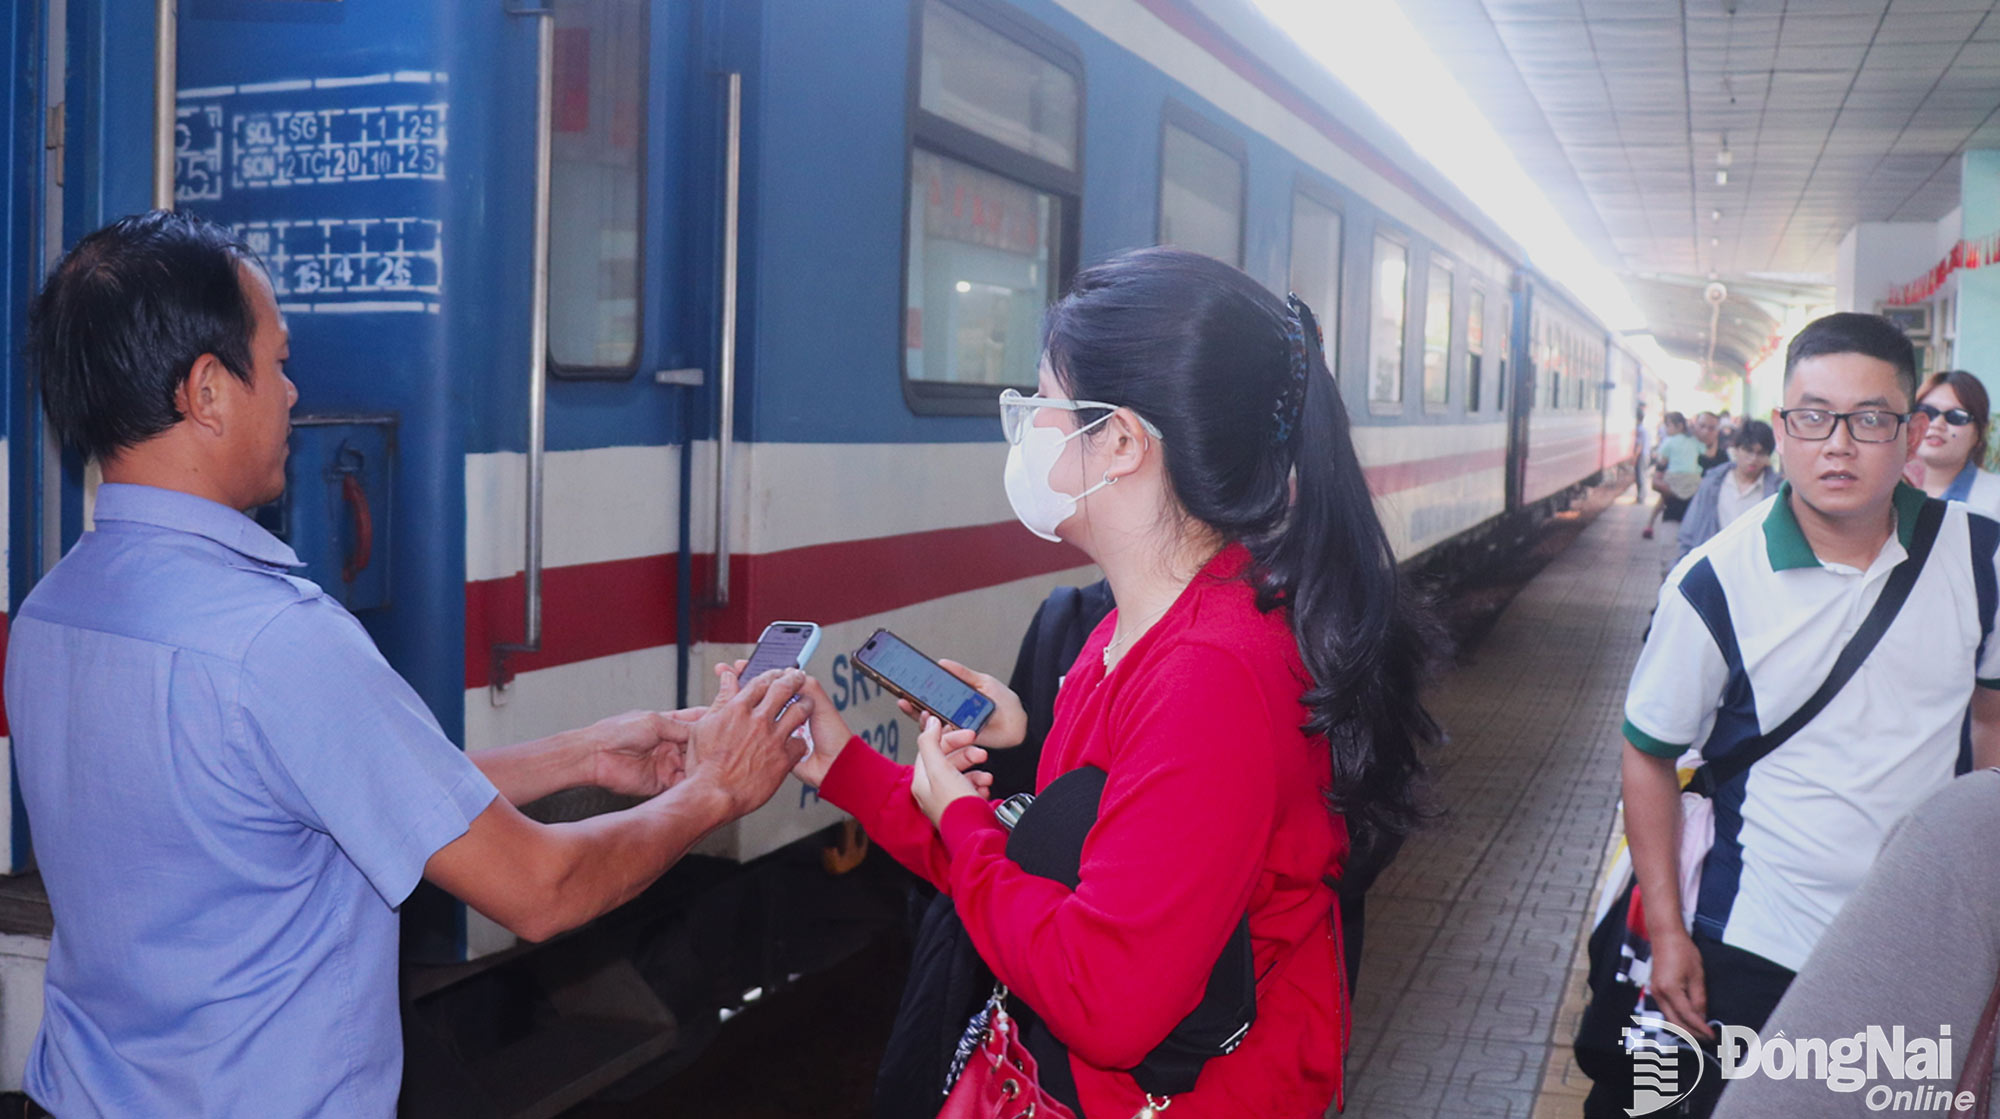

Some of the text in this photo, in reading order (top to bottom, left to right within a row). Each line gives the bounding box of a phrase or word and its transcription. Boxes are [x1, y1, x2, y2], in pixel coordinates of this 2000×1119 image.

[246, 121, 275, 145] SCL
[289, 117, 318, 141] SG
[377, 116, 386, 138] 1
[333, 149, 360, 175] 20
[371, 151, 391, 173] 10
[408, 145, 436, 171] 25
